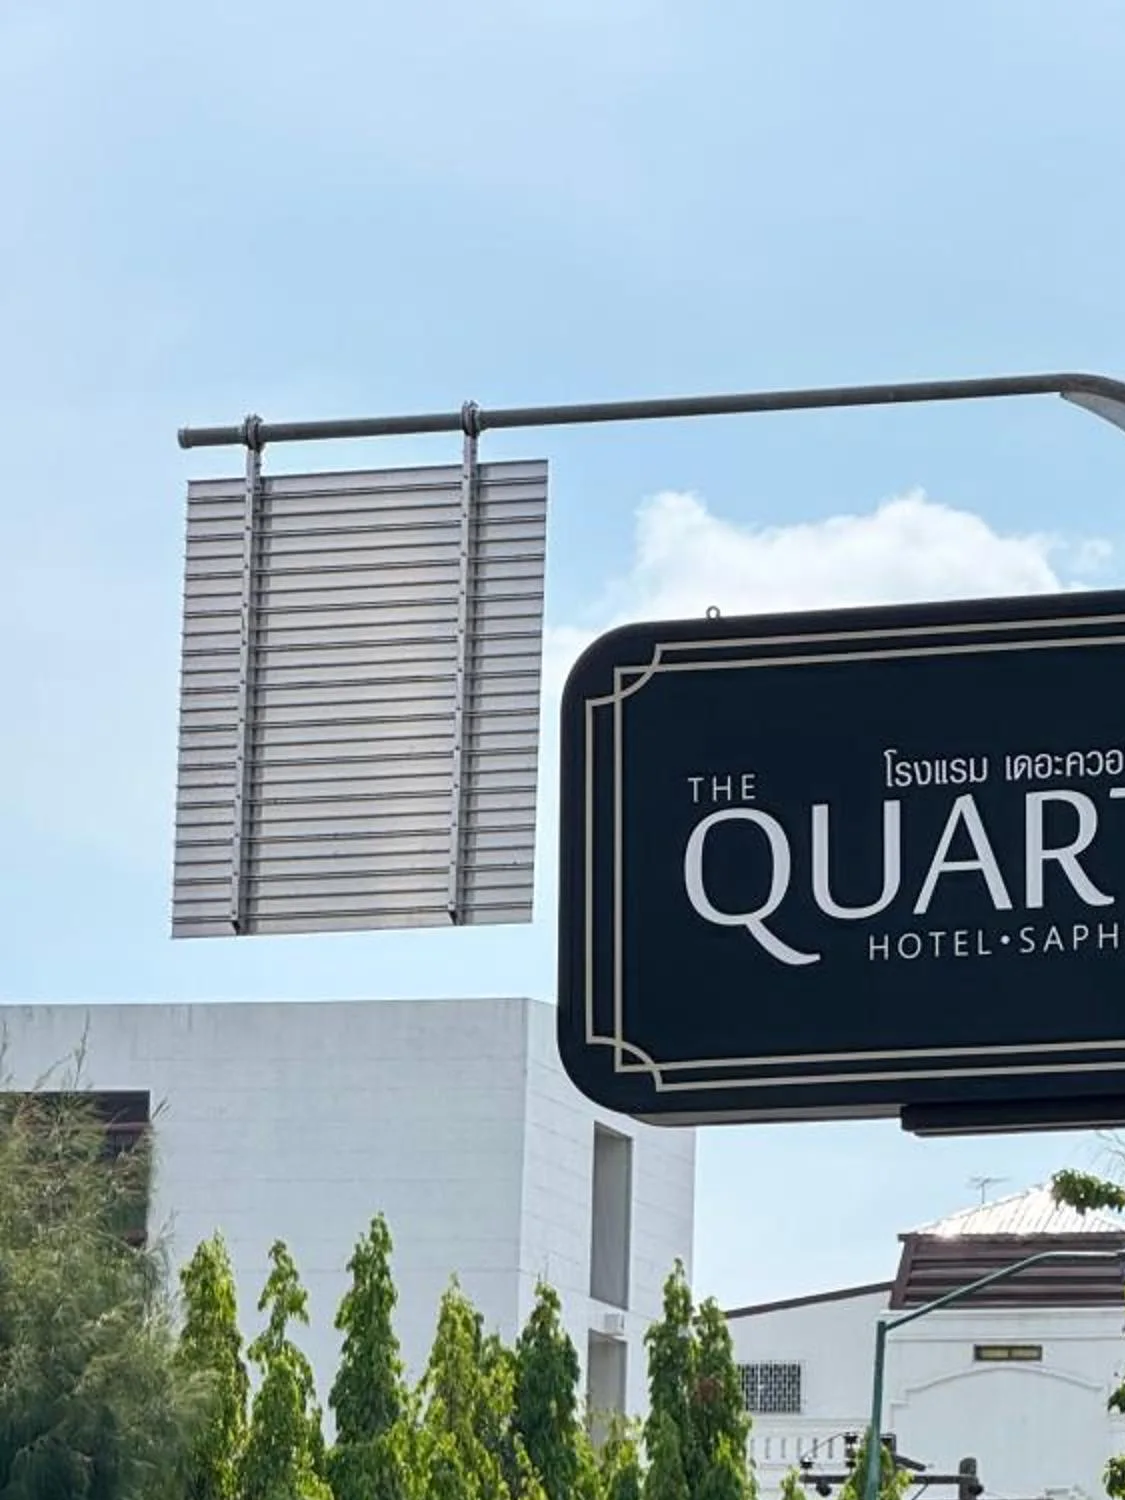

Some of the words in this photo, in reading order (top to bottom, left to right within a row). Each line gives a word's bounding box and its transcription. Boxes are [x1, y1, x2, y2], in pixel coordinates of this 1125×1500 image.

[883, 748, 988, 787] โรงแรม
[687, 774, 756, 803] THE
